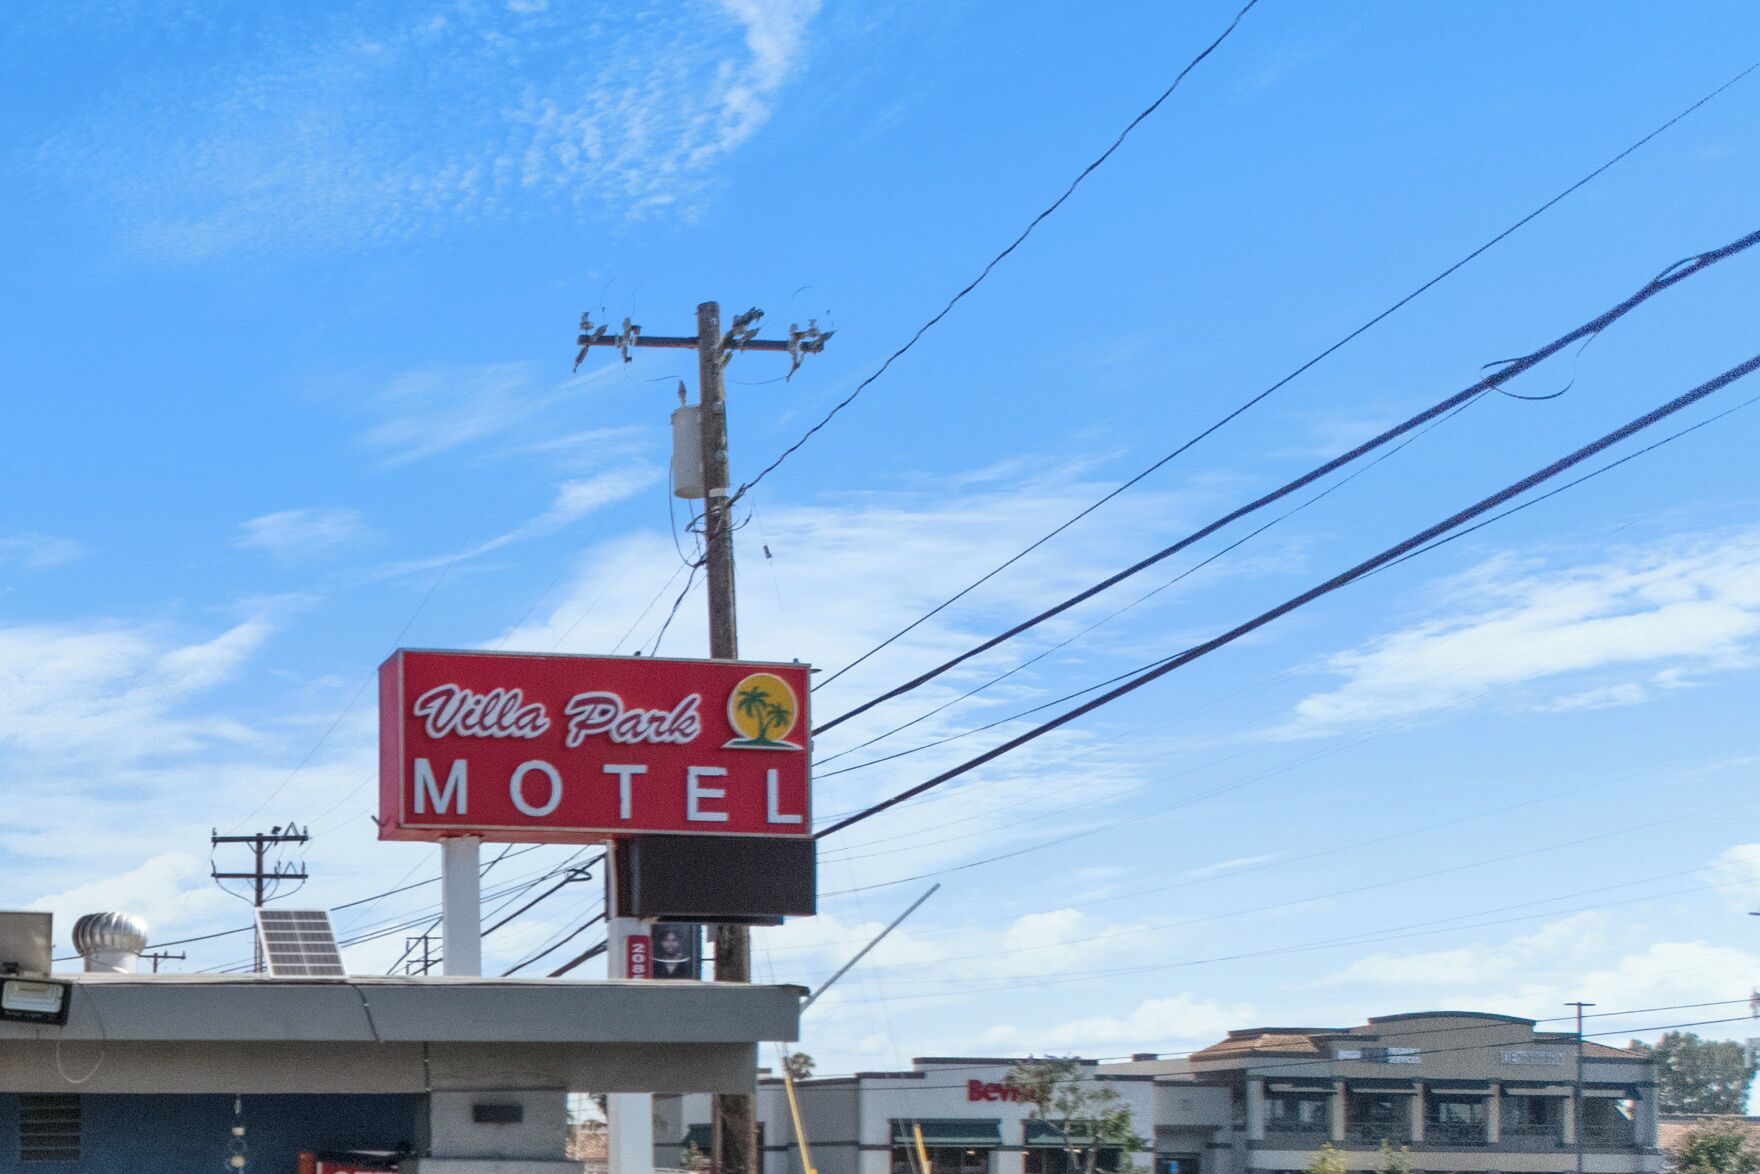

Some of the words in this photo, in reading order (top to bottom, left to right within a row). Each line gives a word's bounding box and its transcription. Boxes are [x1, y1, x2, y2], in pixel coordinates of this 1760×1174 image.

[413, 683, 550, 739] Villa
[564, 690, 701, 748] Park
[413, 757, 802, 824] MOTEL
